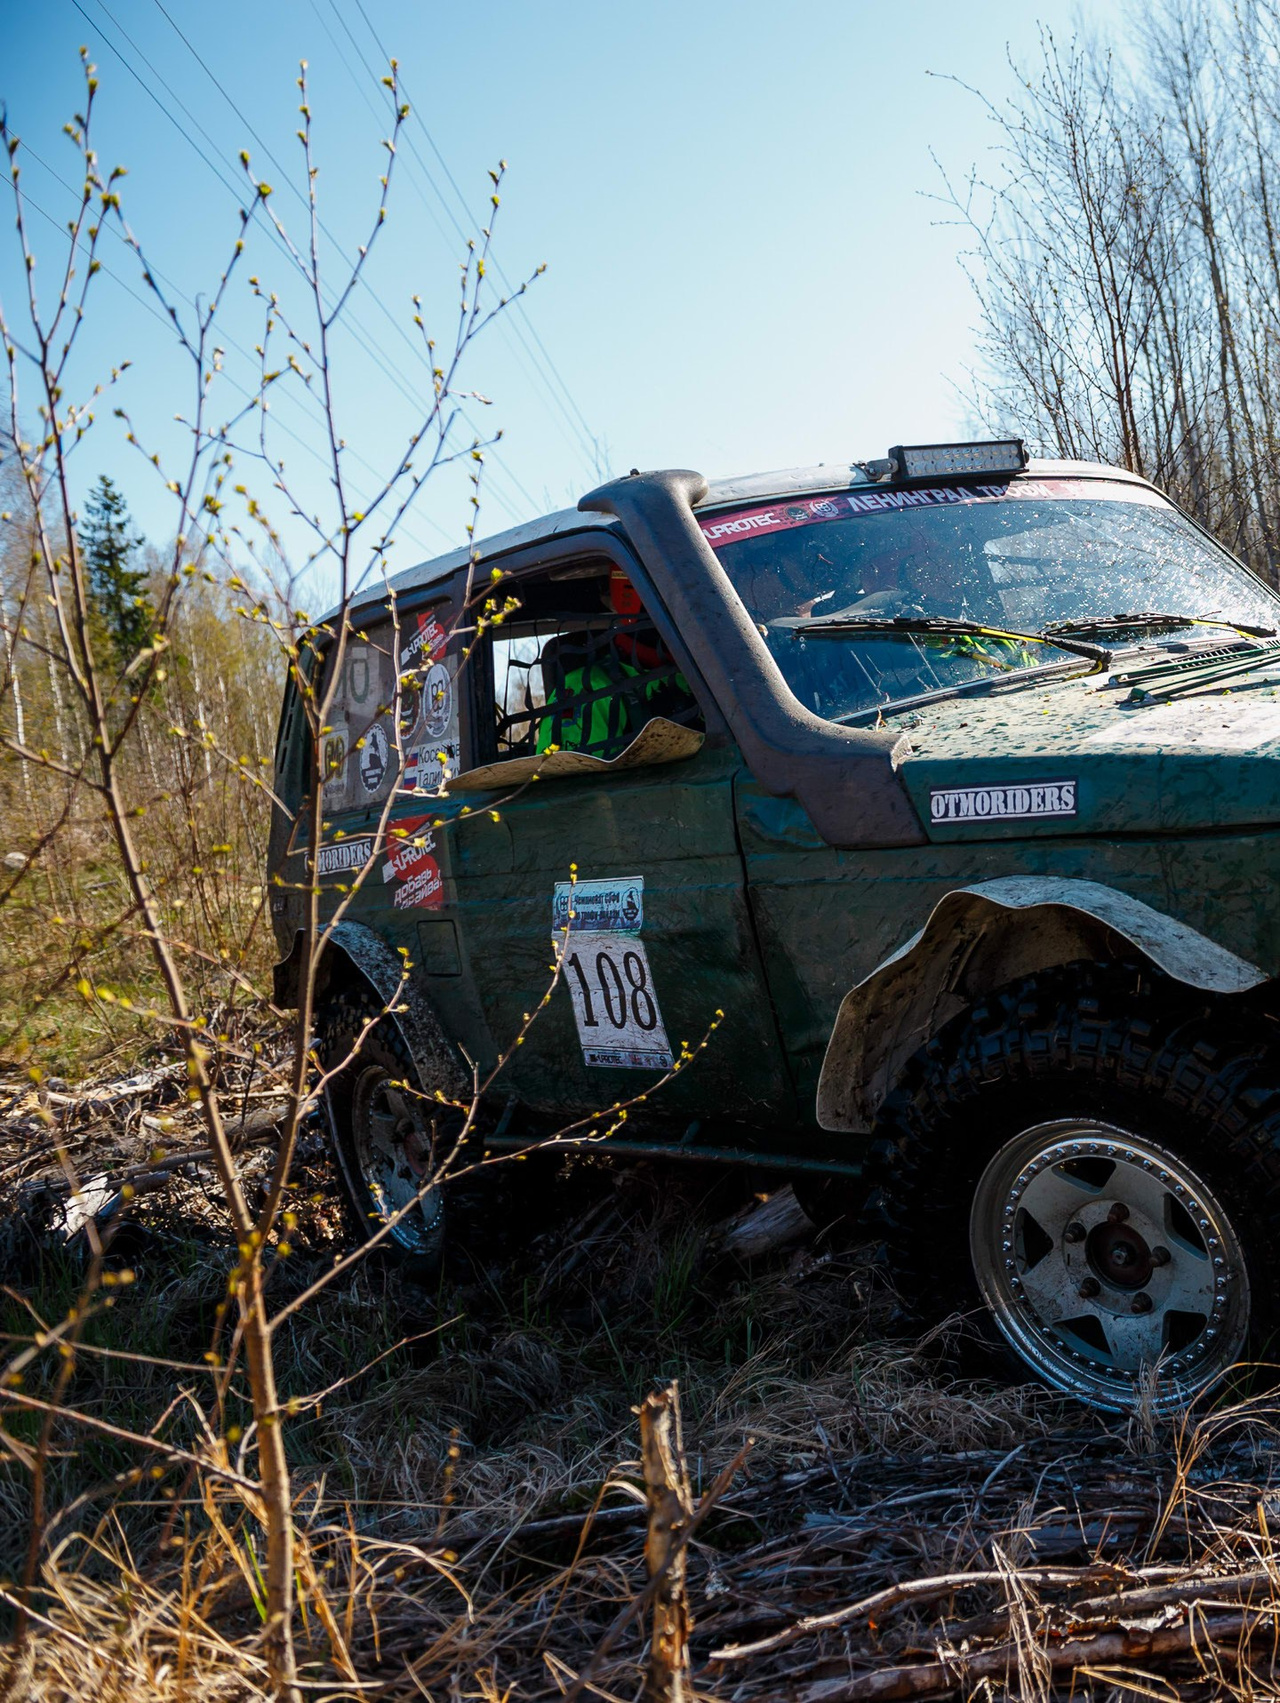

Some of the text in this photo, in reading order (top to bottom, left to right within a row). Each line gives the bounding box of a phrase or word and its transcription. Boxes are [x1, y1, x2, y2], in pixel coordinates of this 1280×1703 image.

[847, 486, 979, 512] ЛЕНИНГРАД
[702, 512, 780, 539] UPROTEC
[931, 786, 1075, 818] OTMORIDERS
[304, 842, 371, 874] MORIDERS
[568, 951, 657, 1031] 108
